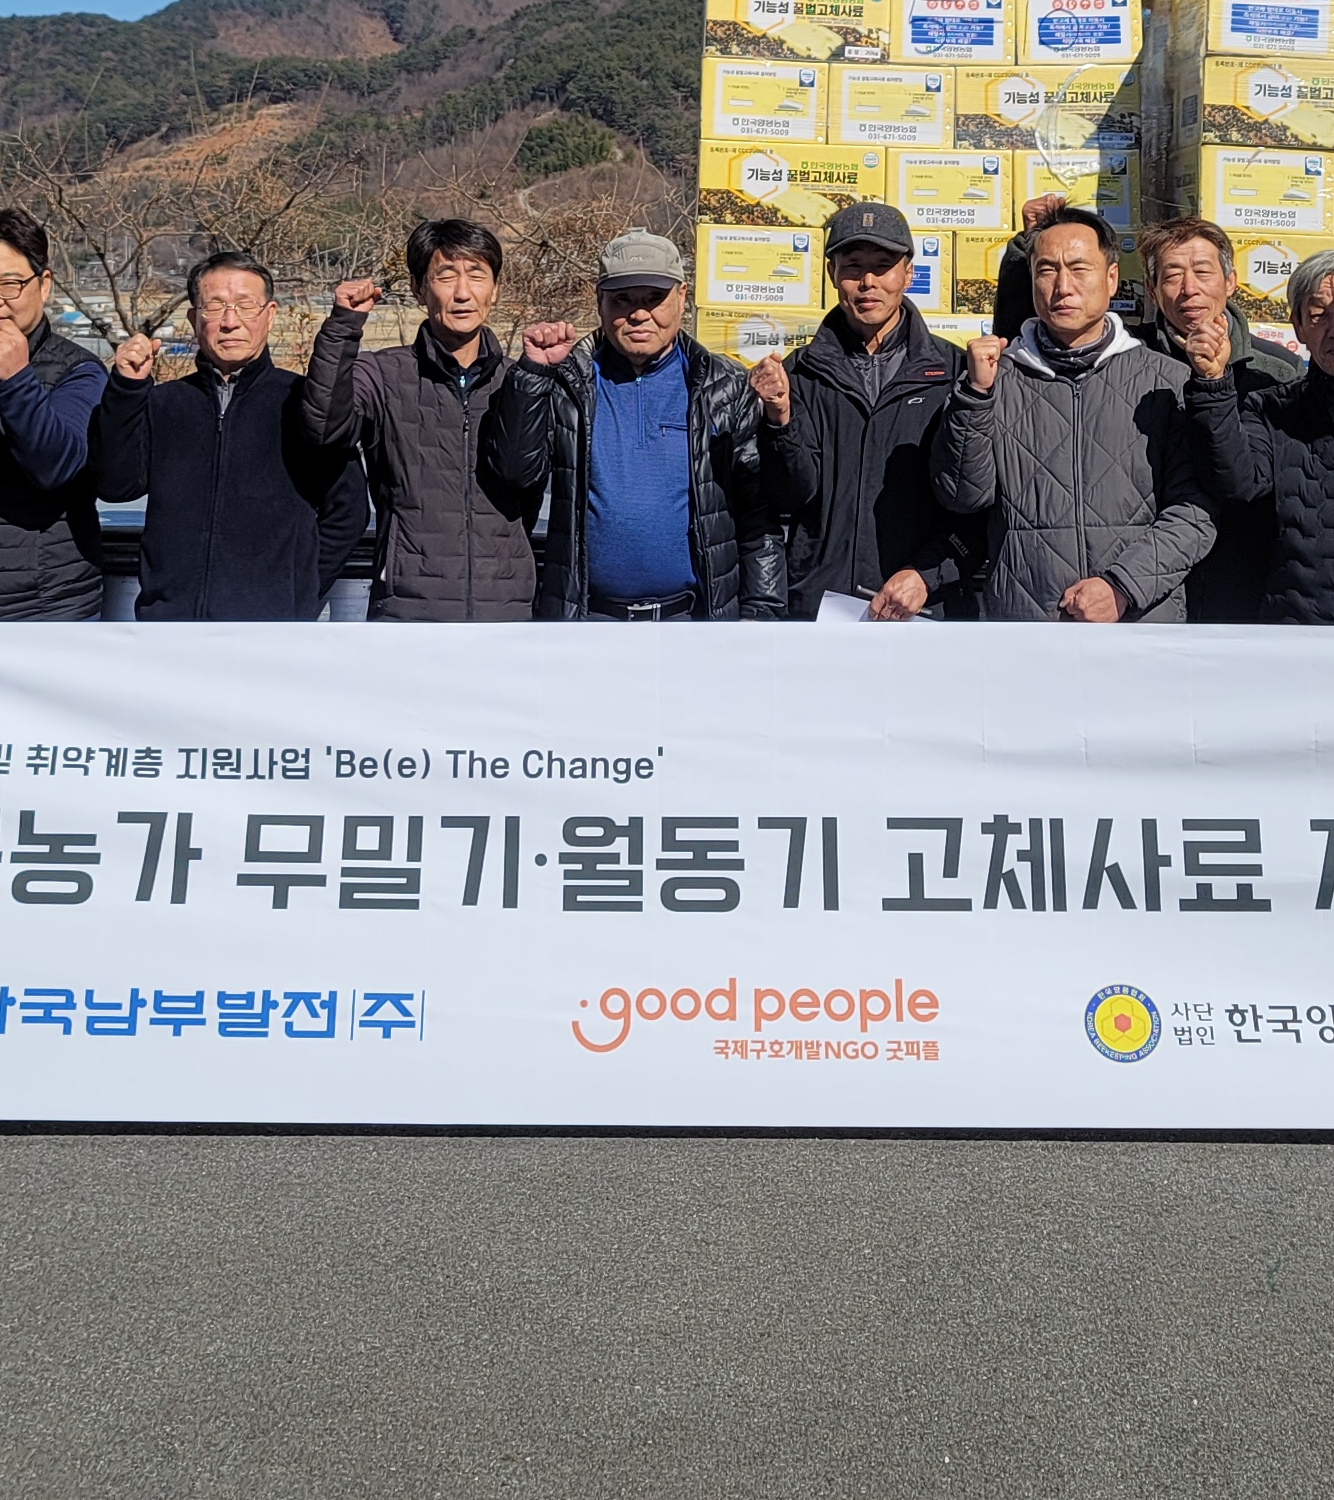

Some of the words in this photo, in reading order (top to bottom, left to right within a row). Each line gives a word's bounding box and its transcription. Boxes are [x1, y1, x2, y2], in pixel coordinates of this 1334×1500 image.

[754, 0, 789, 14] 기능성
[793, 2, 864, 18] 꿀벌고체사료
[1004, 92, 1039, 104] 기능성
[1254, 84, 1292, 98] 기능성
[741, 128, 789, 136] 031-671-5009
[747, 168, 783, 181] 기능성
[787, 170, 858, 184] 꿀벌고체사료
[926, 217, 975, 225] 031-671-5009
[1244, 219, 1295, 227] 031-671-5009
[1254, 261, 1292, 275] 기능성
[743, 333, 779, 346] 기능성
[25, 745, 163, 779] 취약계층
[175, 747, 311, 781] 지원사업
[325, 745, 431, 780] 'Be(e)
[445, 749, 510, 780] The
[522, 746, 665, 784] Change'
[236, 813, 840, 913] 무밀기·월동기
[882, 813, 1272, 912] 고체사료
[571, 977, 737, 1053] good
[753, 978, 940, 1033] people
[1170, 1002, 1215, 1022] 사단
[1172, 1025, 1217, 1046] 법인
[712, 1039, 880, 1061] 국제구호개발NGO
[886, 1040, 940, 1062] 굿피플
